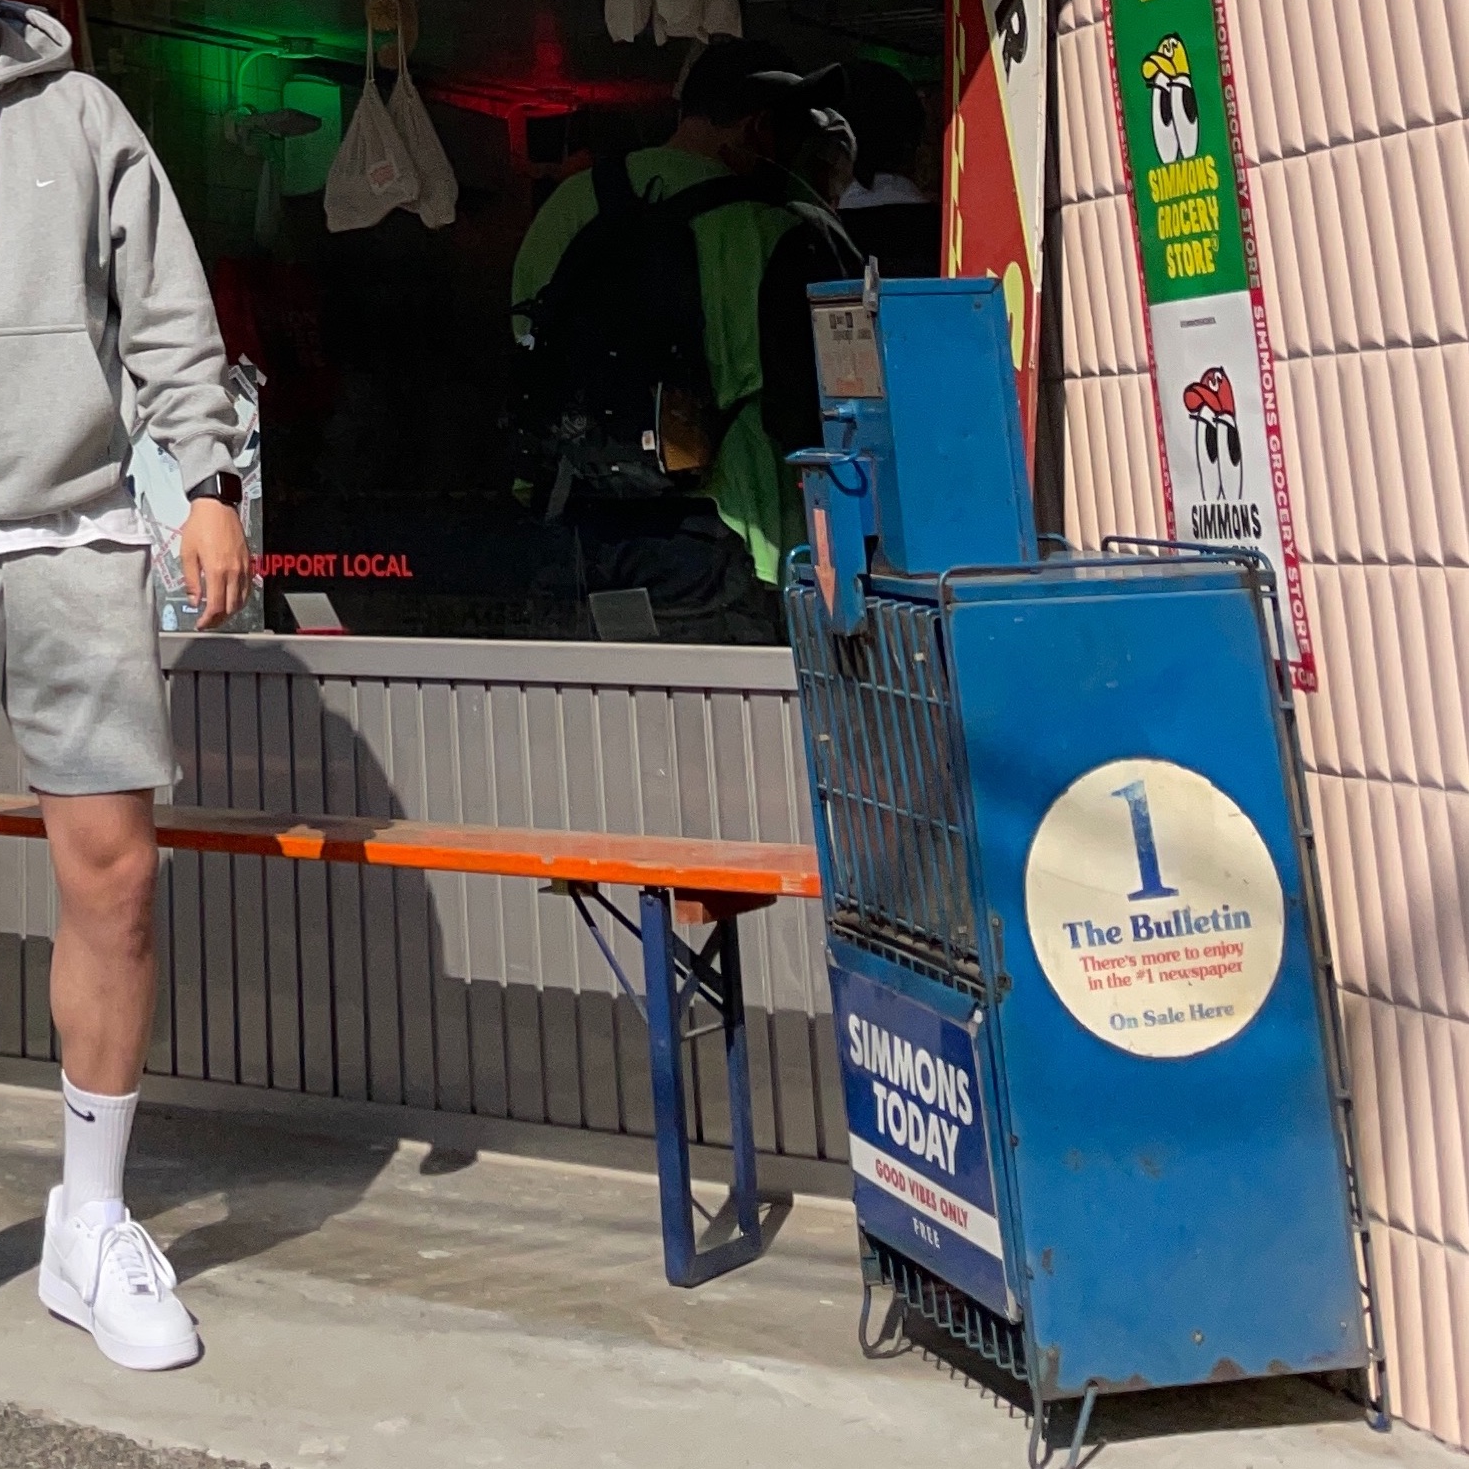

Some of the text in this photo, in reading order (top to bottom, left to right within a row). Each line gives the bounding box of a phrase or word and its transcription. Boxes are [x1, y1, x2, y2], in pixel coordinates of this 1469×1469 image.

[1148, 154, 1220, 203] SIMMONS
[1157, 194, 1220, 240] GROCERY
[1166, 236, 1216, 279] STORE
[1224, 86, 1249, 199] GROCERY
[1240, 207, 1261, 289] STORE
[1253, 305, 1278, 427] SIMMONS
[1268, 435, 1296, 559] GROCERY
[1287, 566, 1312, 654] STORE
[1191, 503, 1262, 540] SIMMONS
[343, 553, 413, 578] LOCAL
[1110, 779, 1180, 903] 1
[1062, 904, 1253, 950] The Bulletin
[1079, 940, 1245, 973] There's more to enjoy
[1088, 960, 1244, 991] in the #1 newspaper
[1109, 1001, 1236, 1031] On Sale Here
[848, 1013, 974, 1126] SIMMONS
[872, 1080, 960, 1177] TODAY
[875, 1158, 970, 1231] GOOD VIBES ONLY
[912, 1216, 941, 1250] FREE
